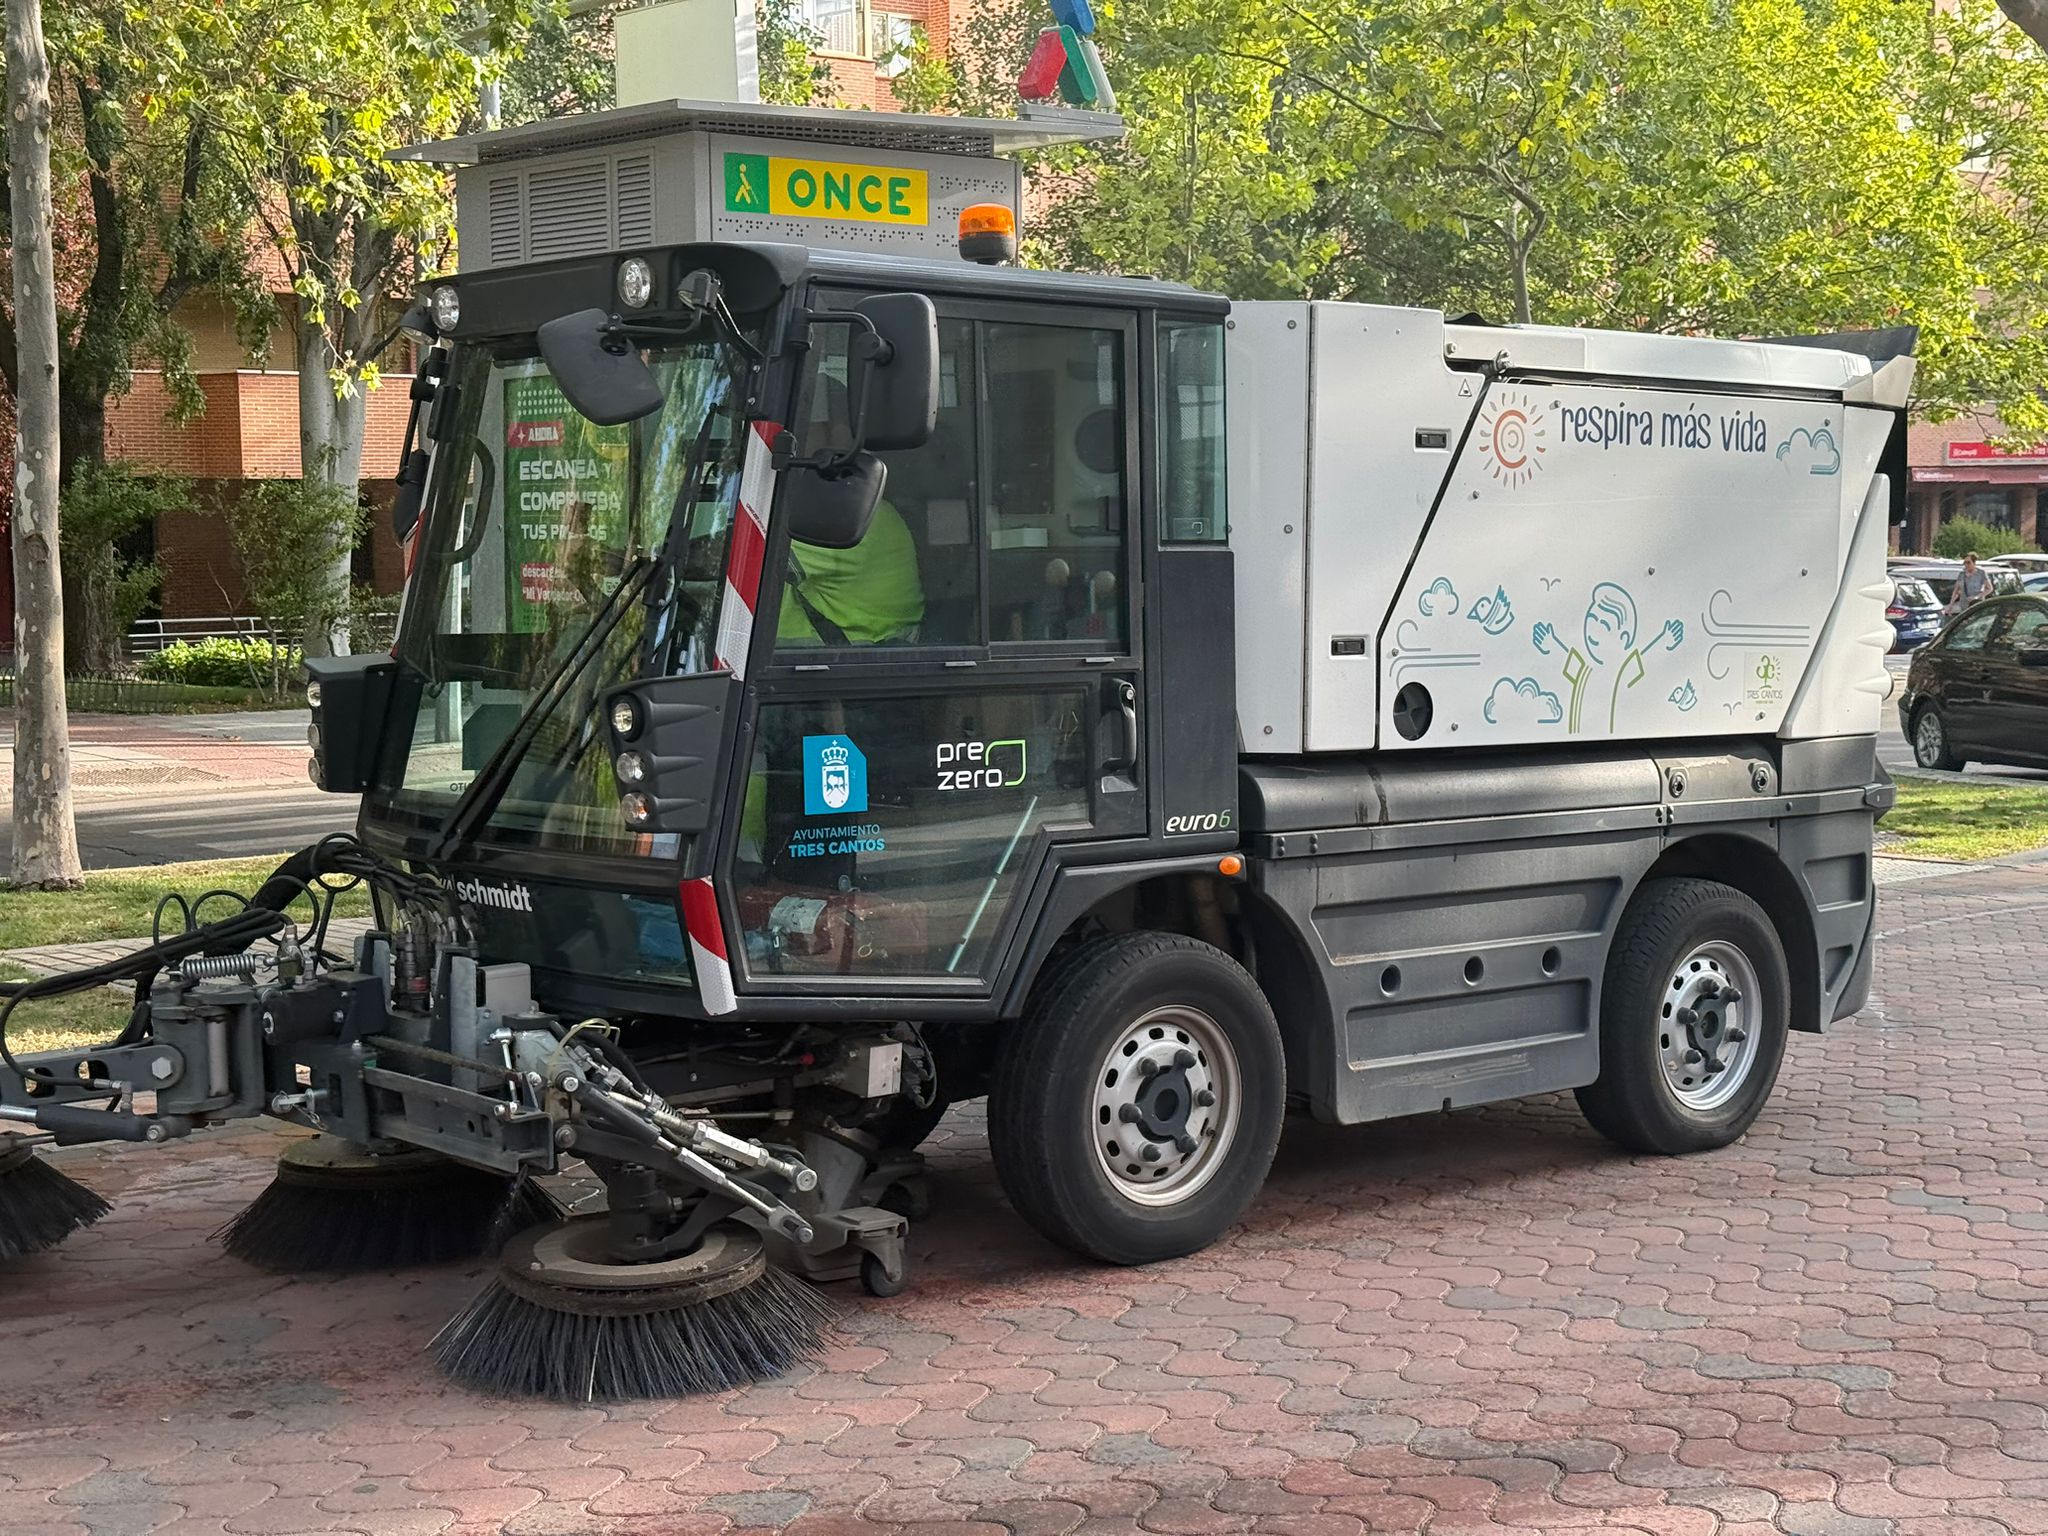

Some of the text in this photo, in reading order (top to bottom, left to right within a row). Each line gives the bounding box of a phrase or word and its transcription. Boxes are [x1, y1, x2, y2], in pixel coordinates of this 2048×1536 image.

[787, 168, 912, 216] ONCE
[528, 426, 559, 441] AHORA
[1561, 401, 1767, 453] respira más vida
[520, 459, 613, 480] ESCANEA Y
[521, 524, 547, 540] TUS
[936, 741, 984, 769] pre
[937, 768, 1003, 790] zero
[793, 824, 881, 841] AYUNTAMIENTO
[788, 838, 886, 858] TRES CANTOS
[456, 878, 533, 912] schmidt
